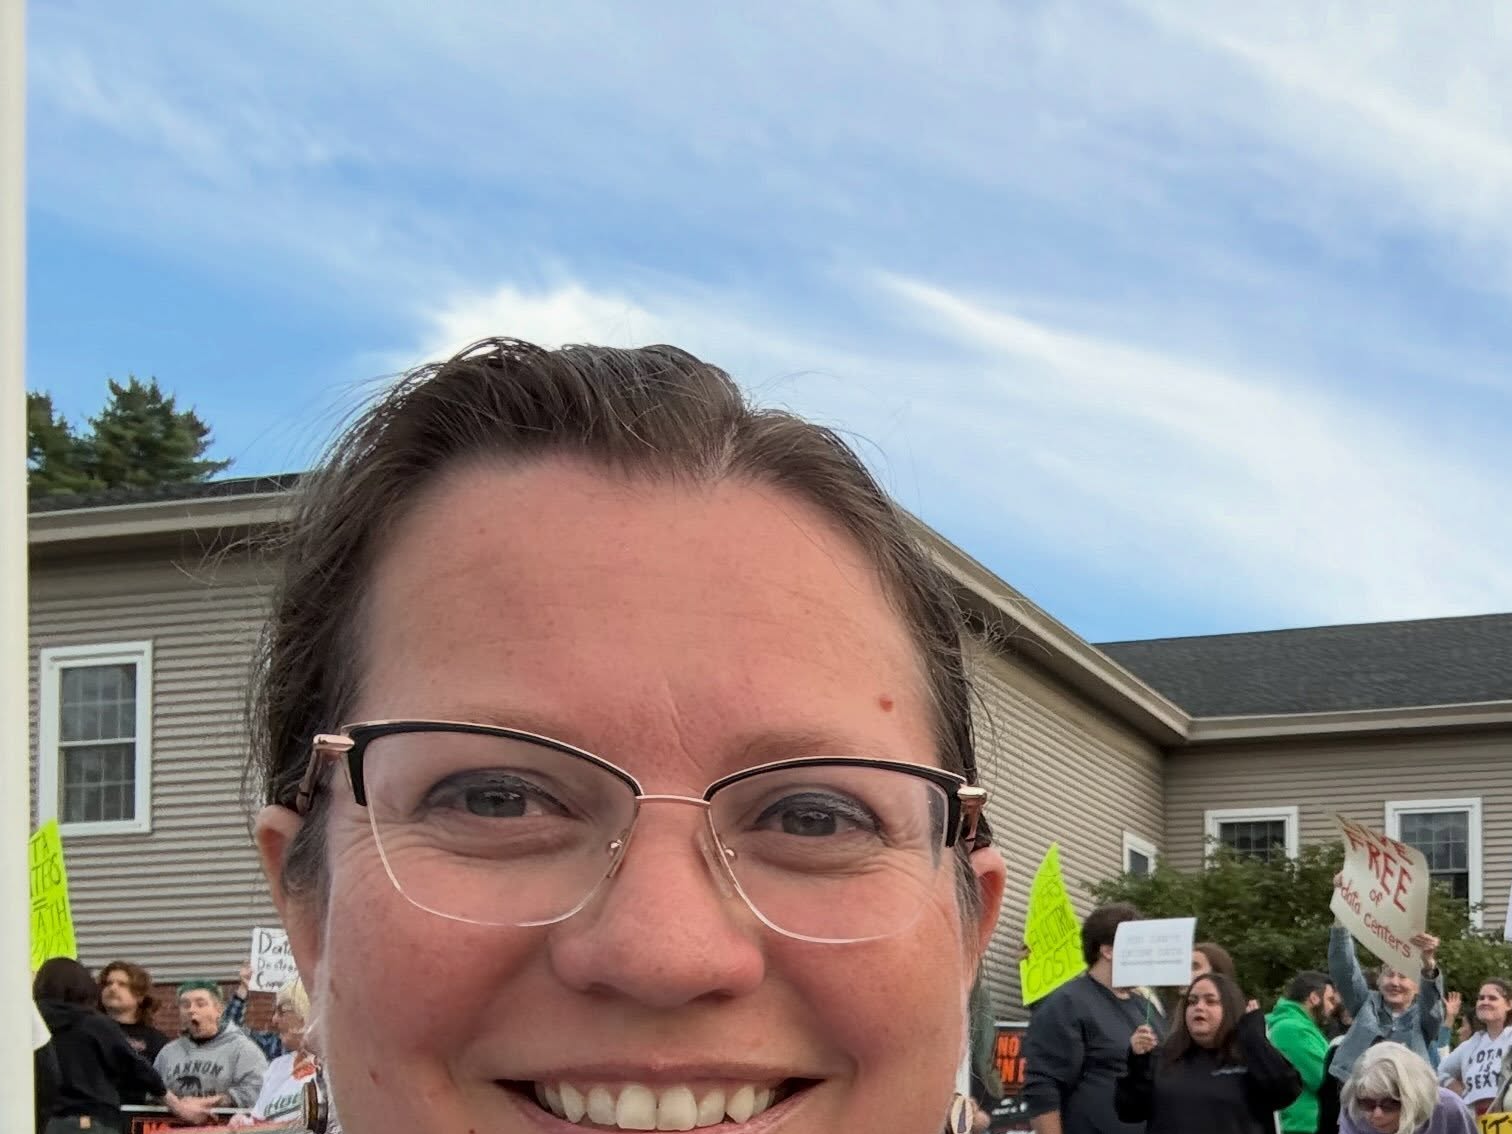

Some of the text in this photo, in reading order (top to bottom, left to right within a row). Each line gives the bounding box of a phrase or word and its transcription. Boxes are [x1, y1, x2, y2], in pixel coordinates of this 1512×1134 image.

[1344, 829, 1412, 912] FREE
[1341, 880, 1361, 914] data
[1369, 889, 1383, 908] of
[1466, 1070, 1500, 1092] SEXY
